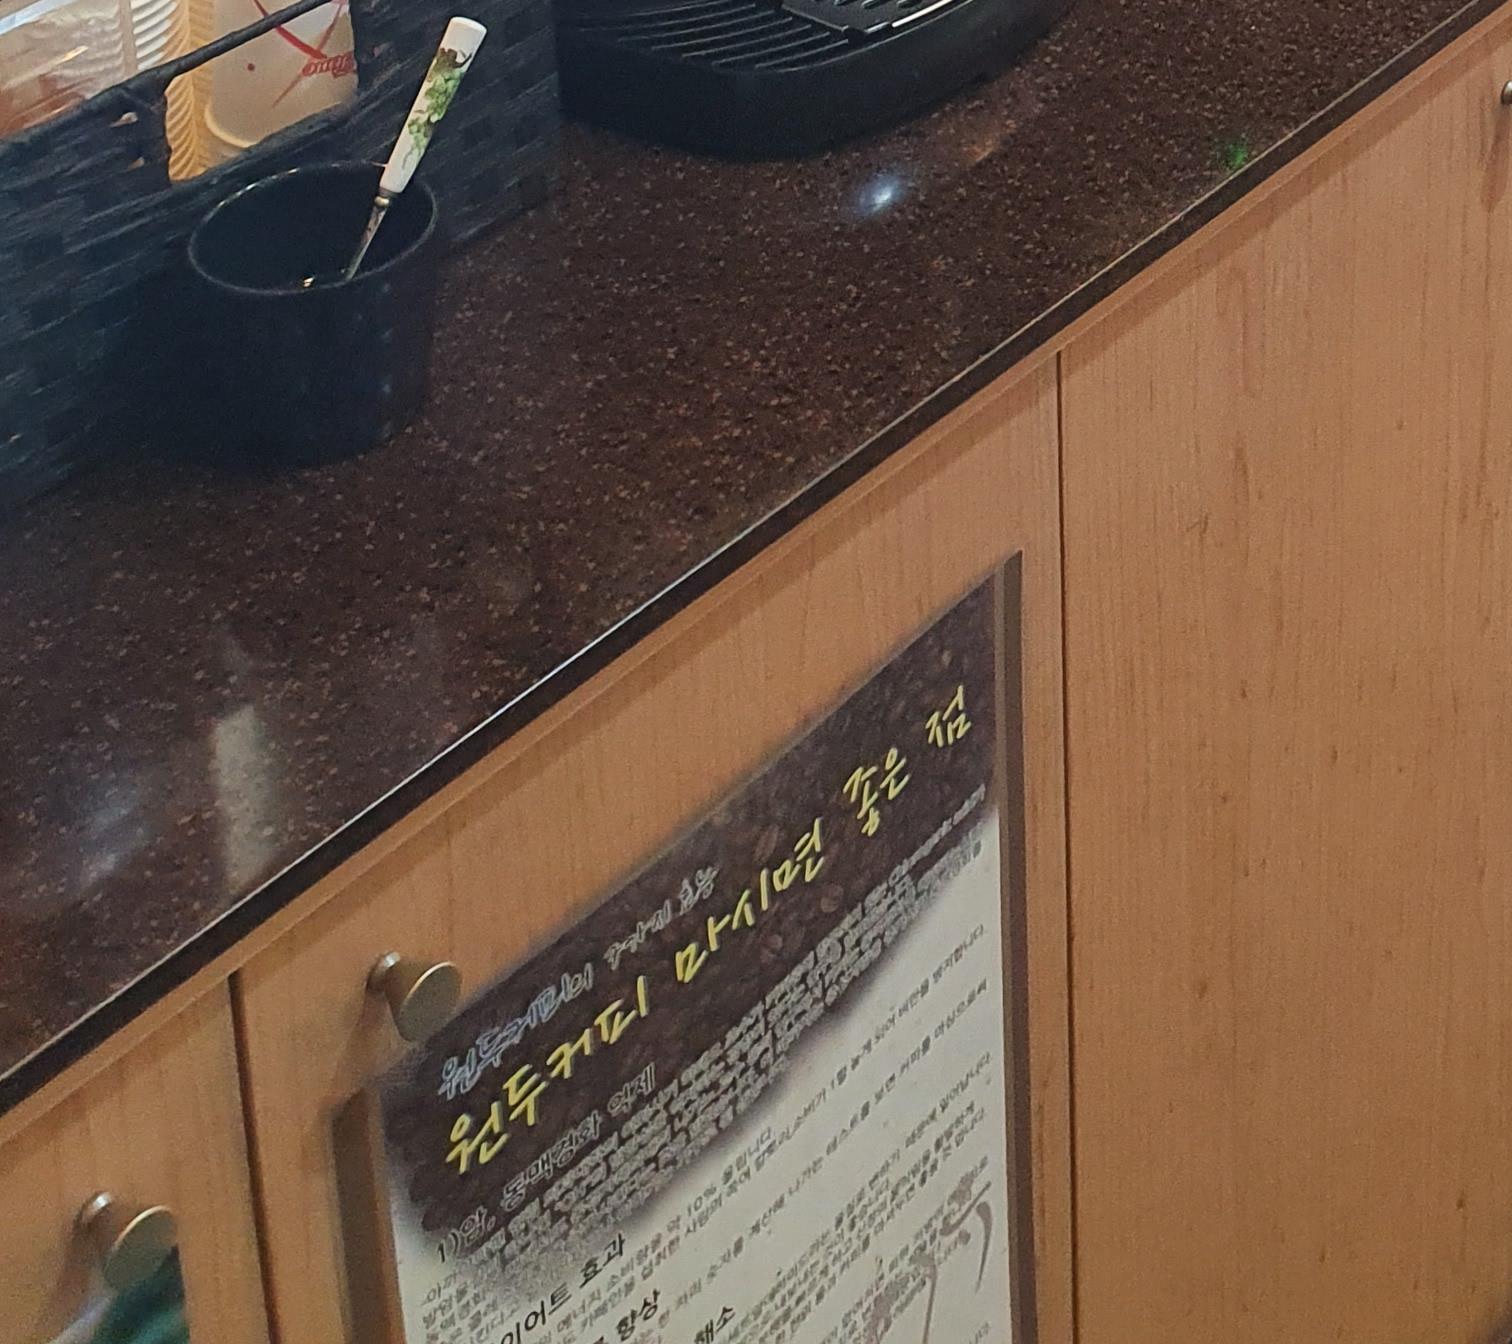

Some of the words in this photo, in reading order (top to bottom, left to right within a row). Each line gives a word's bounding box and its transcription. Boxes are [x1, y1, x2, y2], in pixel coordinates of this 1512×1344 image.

[446, 975, 648, 1171] 원두커피
[675, 816, 824, 981] 마시면
[843, 749, 911, 831] 좋은
[926, 682, 971, 746] 점
[686, 1180, 716, 1216] 10%
[579, 1230, 625, 1287] 효과
